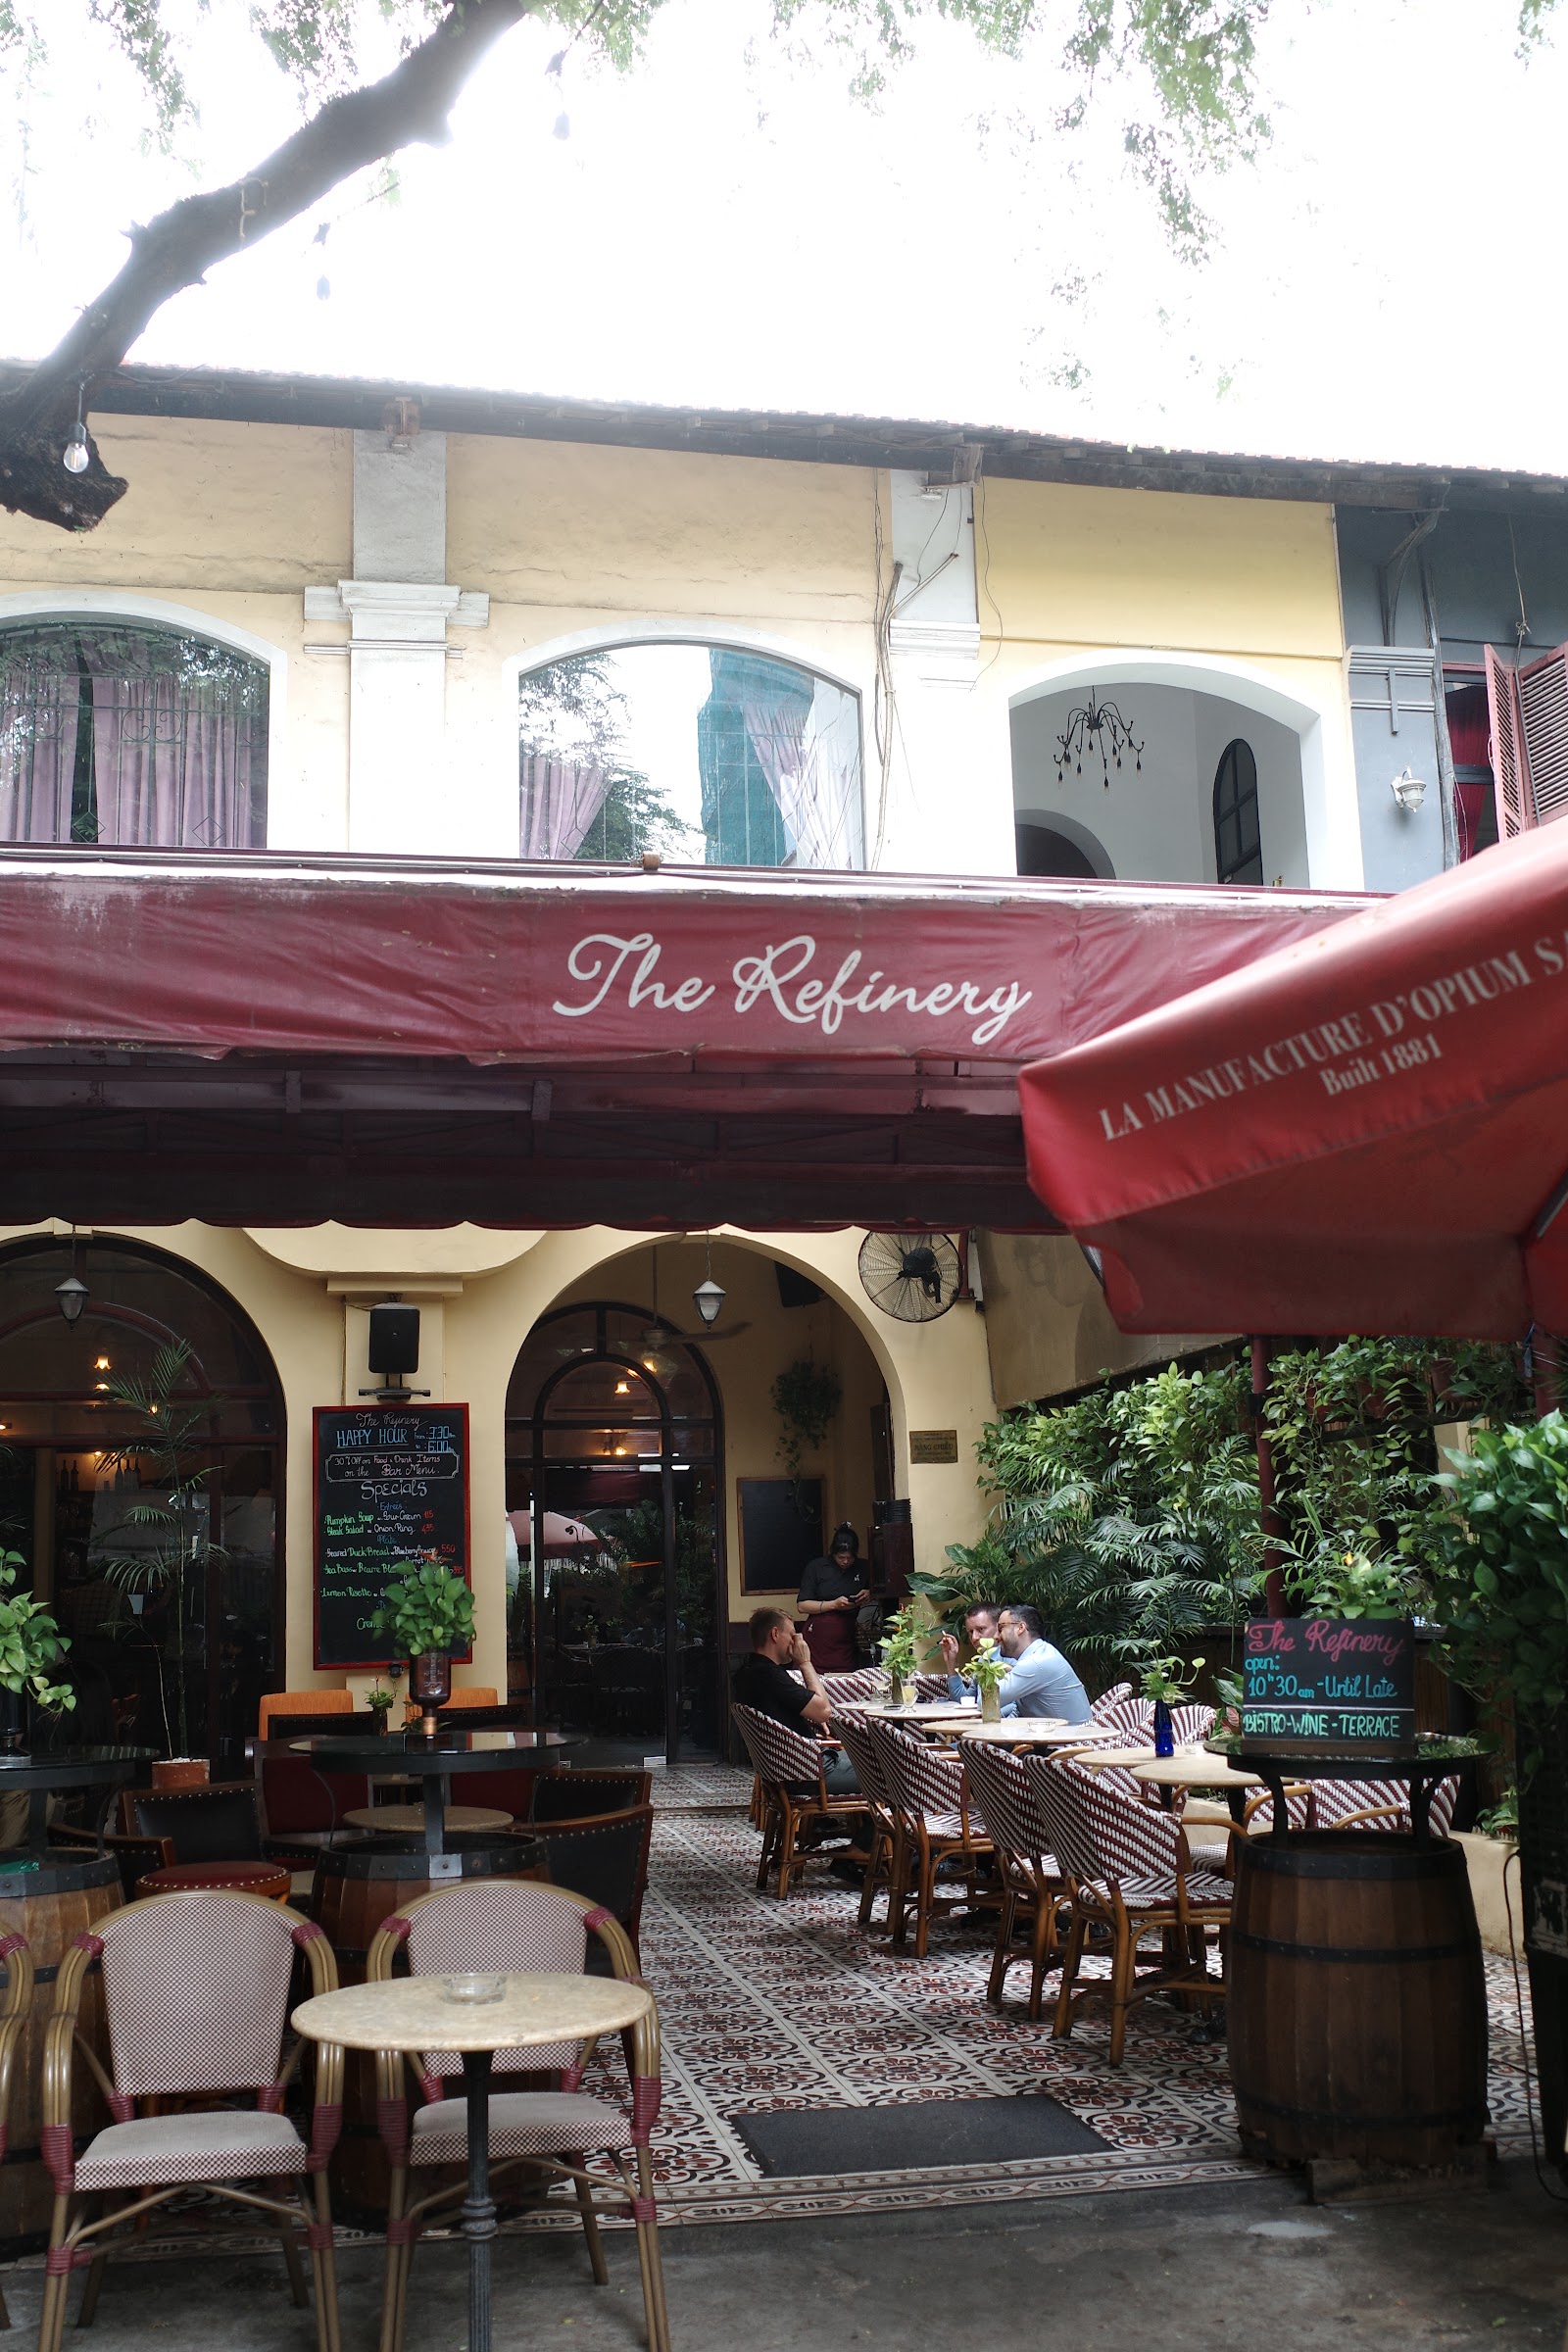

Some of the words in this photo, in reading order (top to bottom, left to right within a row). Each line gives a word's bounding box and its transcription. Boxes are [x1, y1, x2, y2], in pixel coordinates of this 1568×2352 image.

[553, 932, 715, 1016] The
[733, 935, 1032, 1046] Refinery
[1320, 1058, 1380, 1096] Built
[1380, 1033, 1443, 1077] 1881
[1099, 1103, 1145, 1141] LA
[1145, 1013, 1374, 1121] MANUFACTURE
[356, 1412, 379, 1427] The
[336, 1428, 371, 1447] HAPPY
[379, 1428, 408, 1445] HOUR
[373, 1455, 388, 1464] Food
[394, 1454, 413, 1464] Drink
[416, 1453, 441, 1463] Items
[357, 1466, 369, 1477] the
[381, 1463, 403, 1476] Bar
[361, 1479, 428, 1503] Specials
[324, 1514, 356, 1527] Pumpkin
[358, 1510, 374, 1524] Soup
[399, 1509, 422, 1521] Cream
[345, 1523, 365, 1535] Salad
[373, 1523, 395, 1533] Onion
[347, 1546, 368, 1557] Duck
[366, 1545, 391, 1556] Breast
[336, 1563, 354, 1575] Bass
[321, 1587, 347, 1597] Lemon
[1248, 1620, 1297, 1652] The
[1304, 1620, 1403, 1666] Refinery
[1245, 1654, 1280, 1674] open:
[1365, 1674, 1397, 1699] Late
[1338, 1715, 1400, 1739] TERRACE
